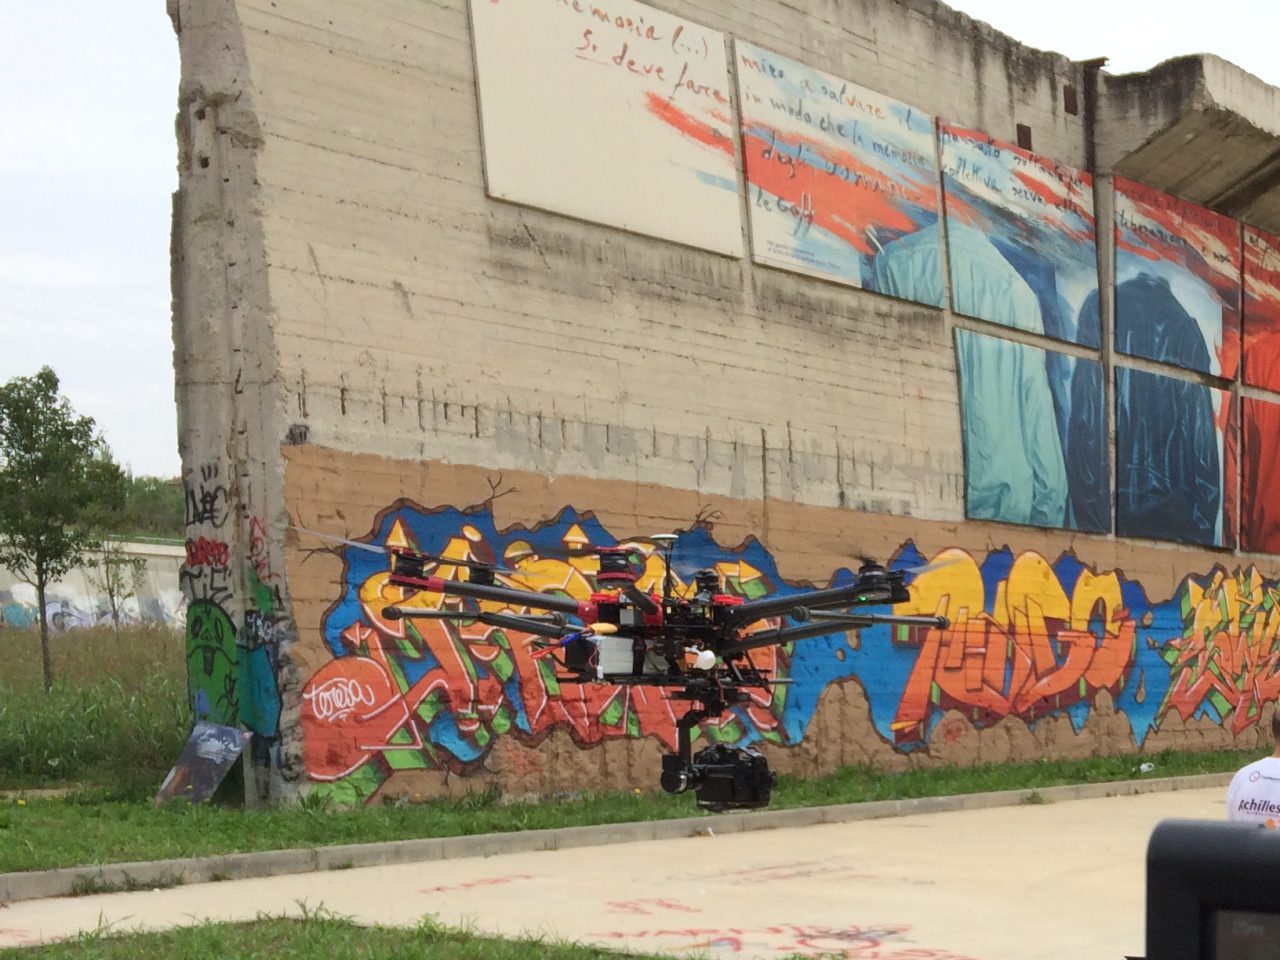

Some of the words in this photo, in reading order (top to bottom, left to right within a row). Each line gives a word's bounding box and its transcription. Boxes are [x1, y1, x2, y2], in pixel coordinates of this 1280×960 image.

[556, 0, 664, 41] emoria
[612, 42, 665, 81] deve
[819, 112, 846, 136] che
